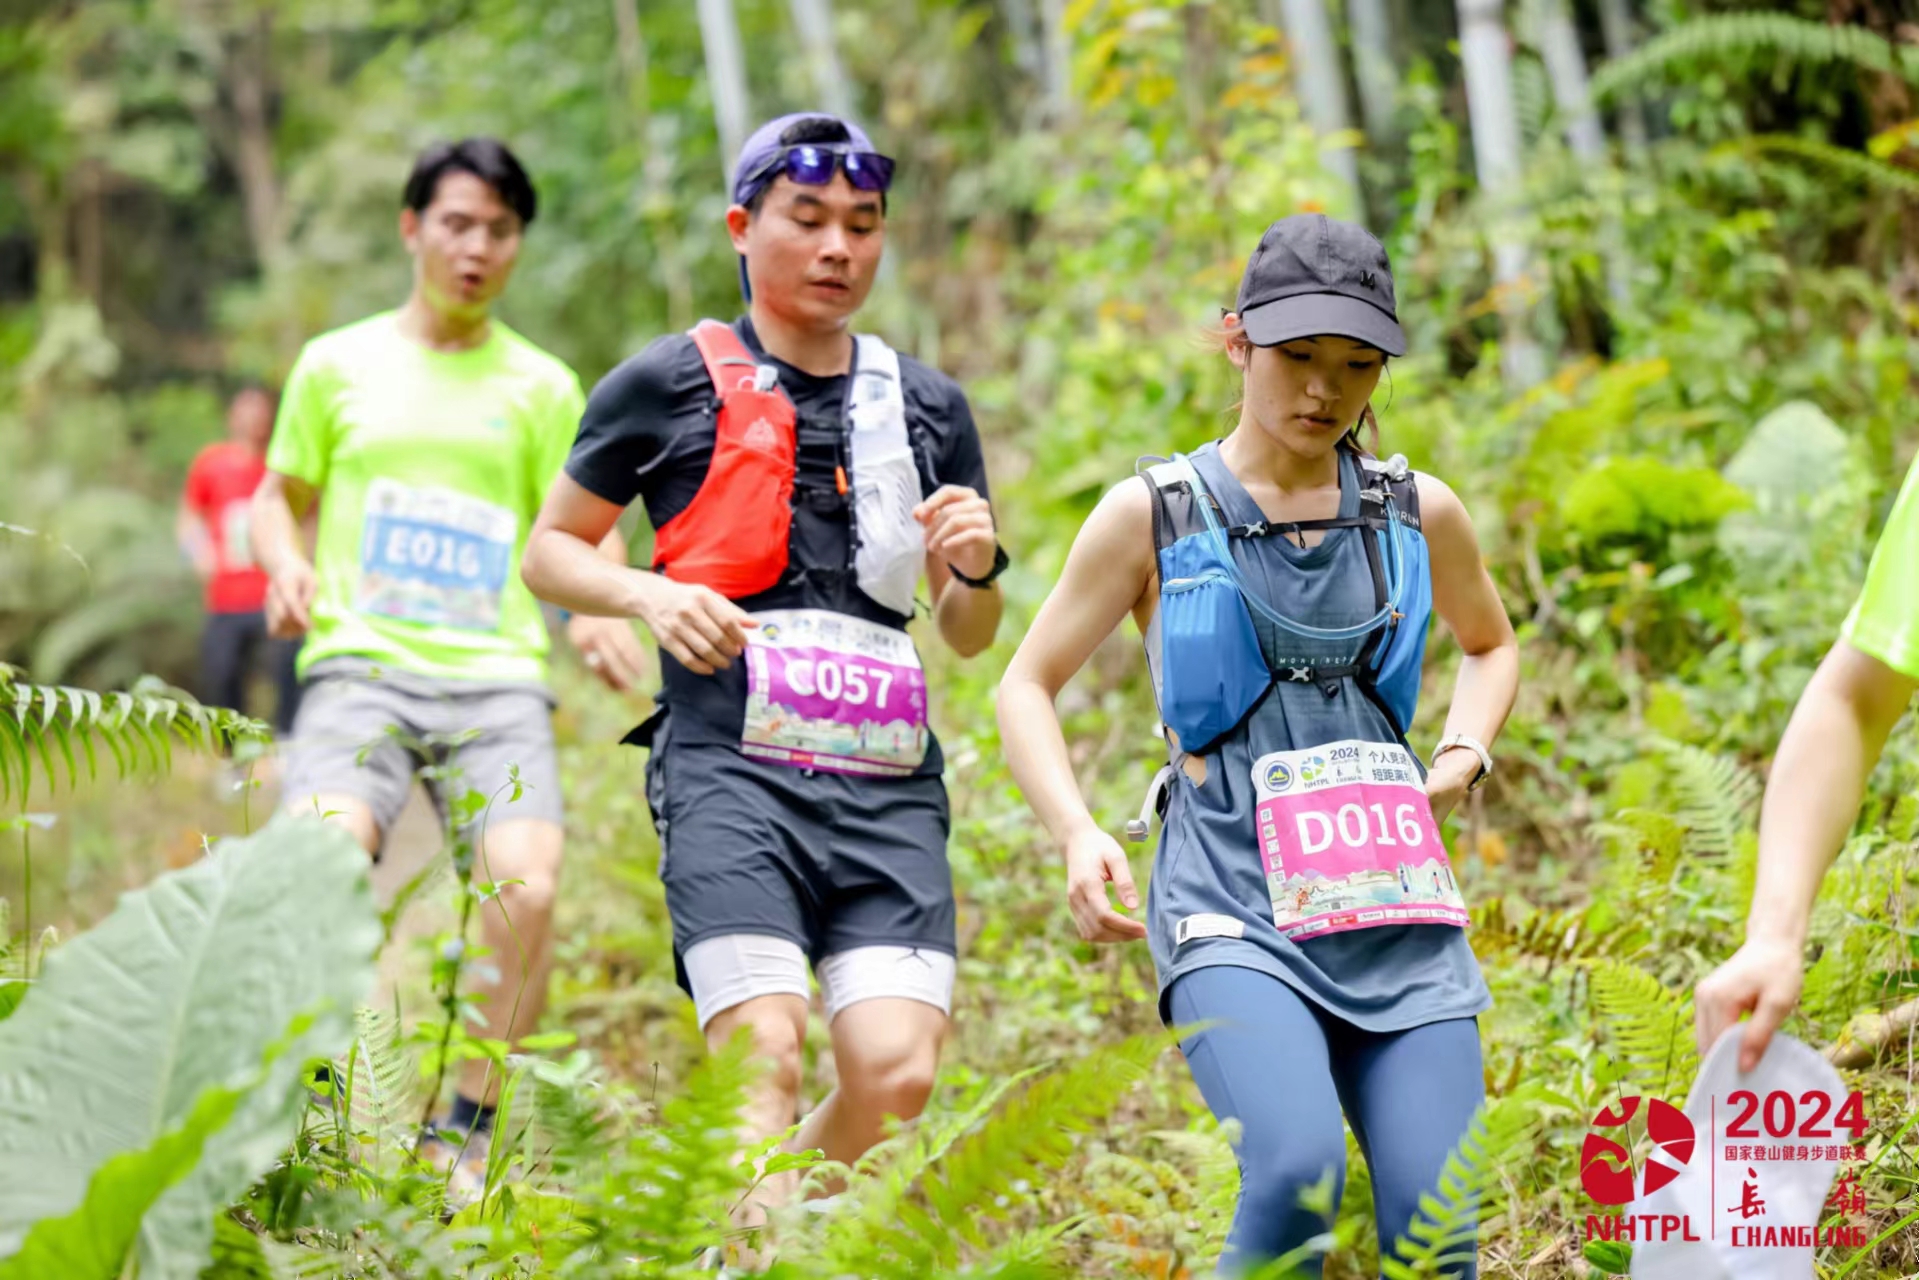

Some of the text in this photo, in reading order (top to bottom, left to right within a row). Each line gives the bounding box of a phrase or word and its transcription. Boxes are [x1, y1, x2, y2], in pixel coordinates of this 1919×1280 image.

[384, 525, 480, 579] E016
[784, 659, 893, 709] C057
[1329, 747, 1360, 760] 2024
[1295, 803, 1424, 855] D016
